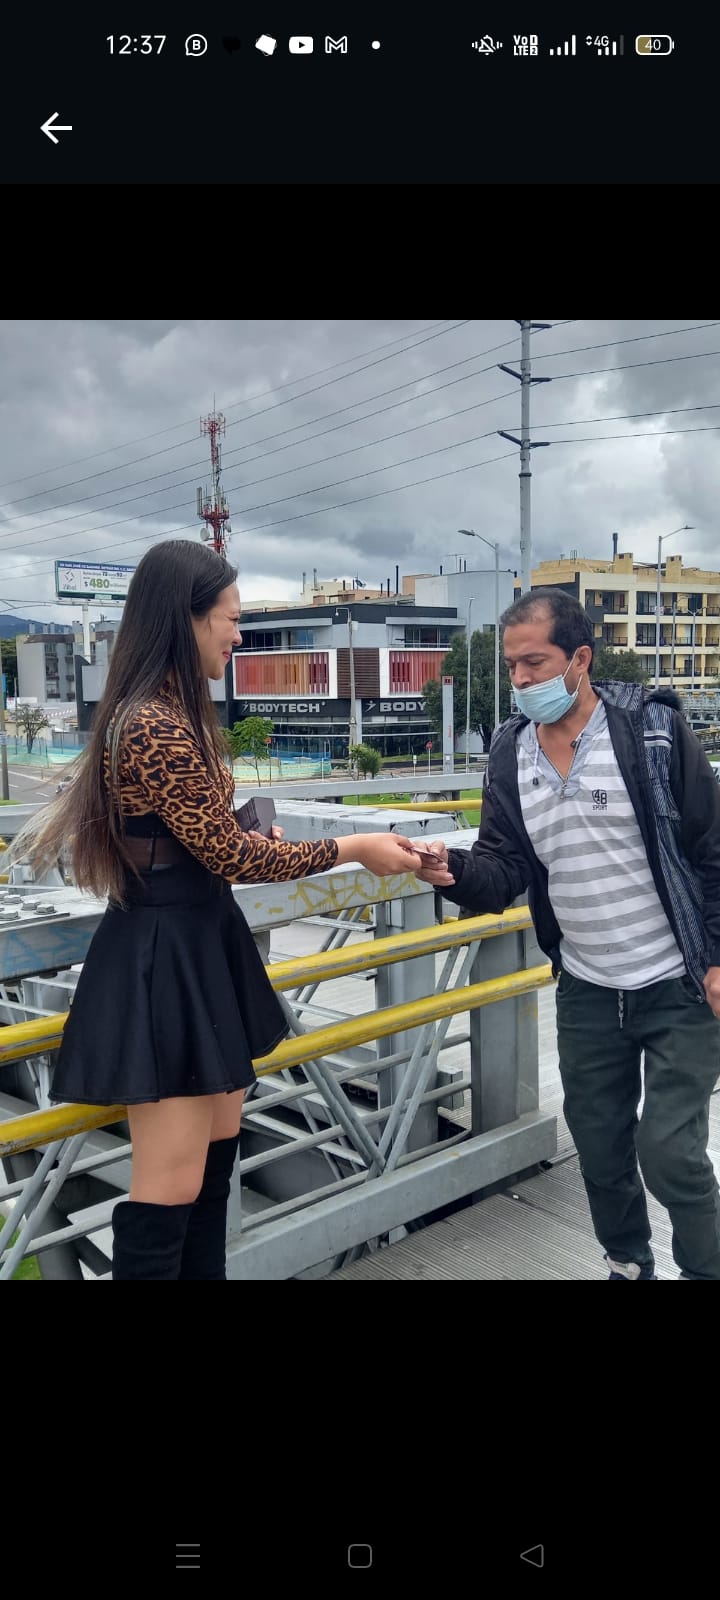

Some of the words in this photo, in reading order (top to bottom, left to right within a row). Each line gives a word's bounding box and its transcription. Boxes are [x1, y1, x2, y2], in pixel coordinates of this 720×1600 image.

[89, 578, 110, 589] 480
[249, 703, 321, 713] BODYTECH
[379, 701, 427, 713] BODY
